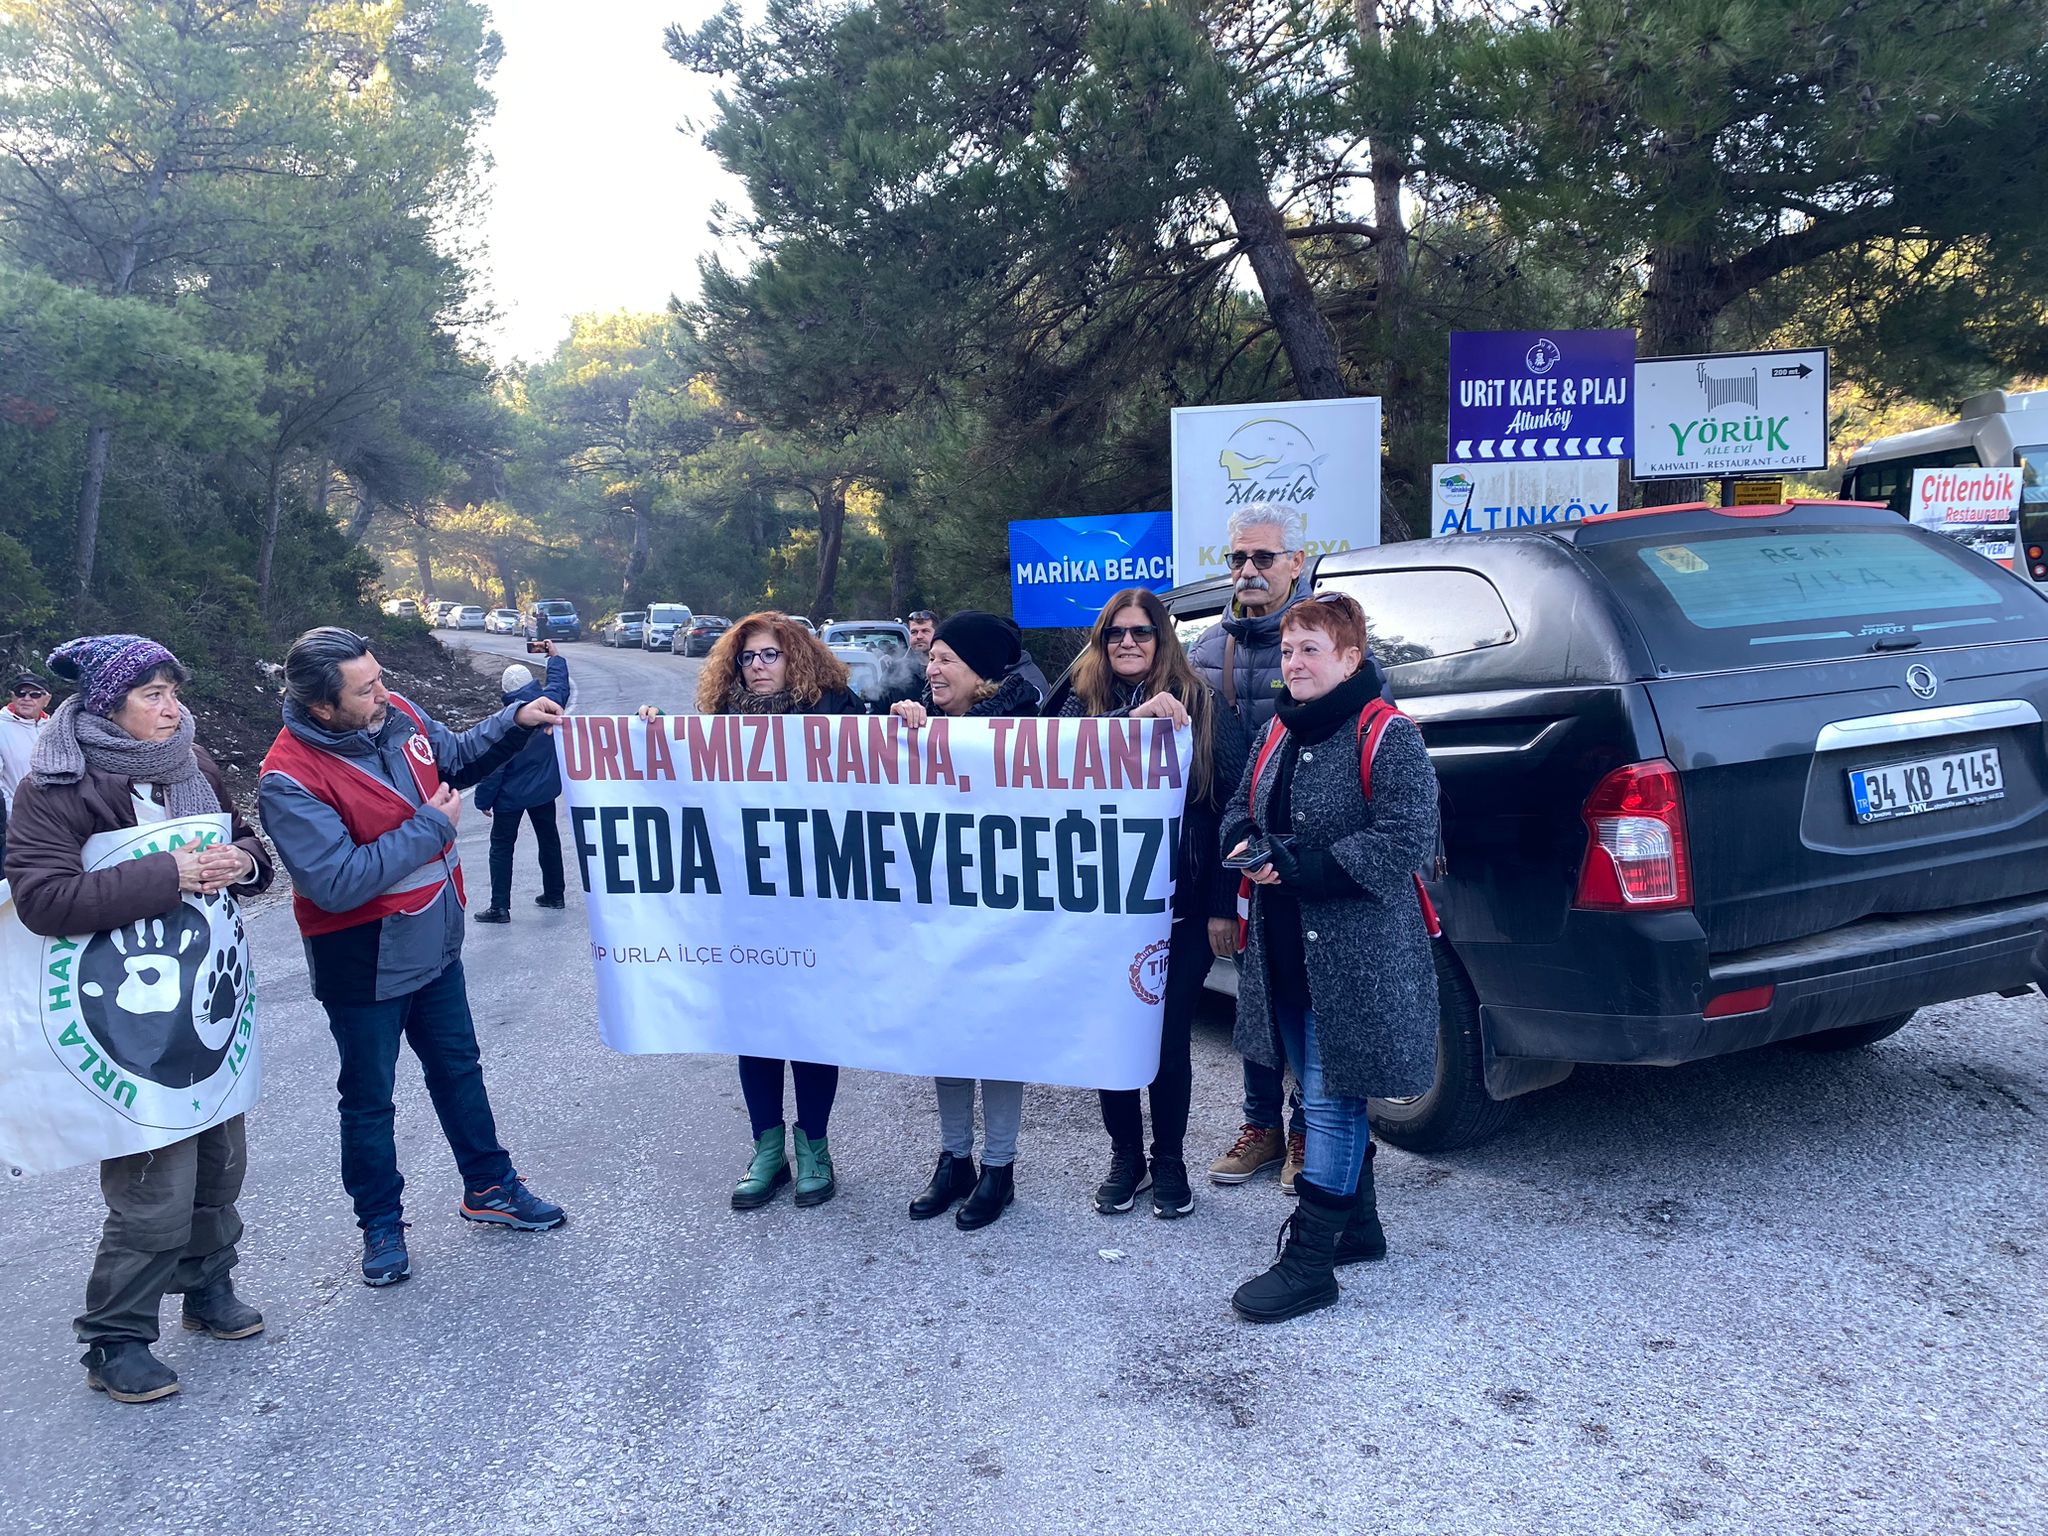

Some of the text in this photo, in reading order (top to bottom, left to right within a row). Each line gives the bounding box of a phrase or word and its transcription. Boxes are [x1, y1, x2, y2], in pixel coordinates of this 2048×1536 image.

[1773, 368, 1800, 377] 200 mt.
[1510, 378, 1557, 406] KAFE
[1562, 378, 1576, 405] &
[1581, 377, 1626, 405] PLAJ
[1505, 407, 1573, 434] Altınköy
[1668, 416, 1790, 456] YÖRÜK
[1704, 443, 1753, 455] AİLE EVİ
[1650, 455, 1807, 472] KAHVALTI RESTAURANT CAFE
[1225, 475, 1318, 504] Marika
[1921, 473, 2014, 510] Çitlenbik
[1946, 506, 2010, 521] Restaurant
[1017, 555, 1100, 585] MARİKA
[1857, 625, 1906, 636] SPORTS
[563, 715, 788, 782] URLA'MIZI
[988, 718, 1183, 790] TALANA
[1857, 752, 1997, 810] TR 34 KB 2145
[571, 806, 721, 895] FEDA
[613, 946, 672, 964] URLA
[679, 943, 723, 966] İLÇE
[729, 944, 817, 968] ÖRGÜTÜ
[57, 1020, 138, 1110] URLA
